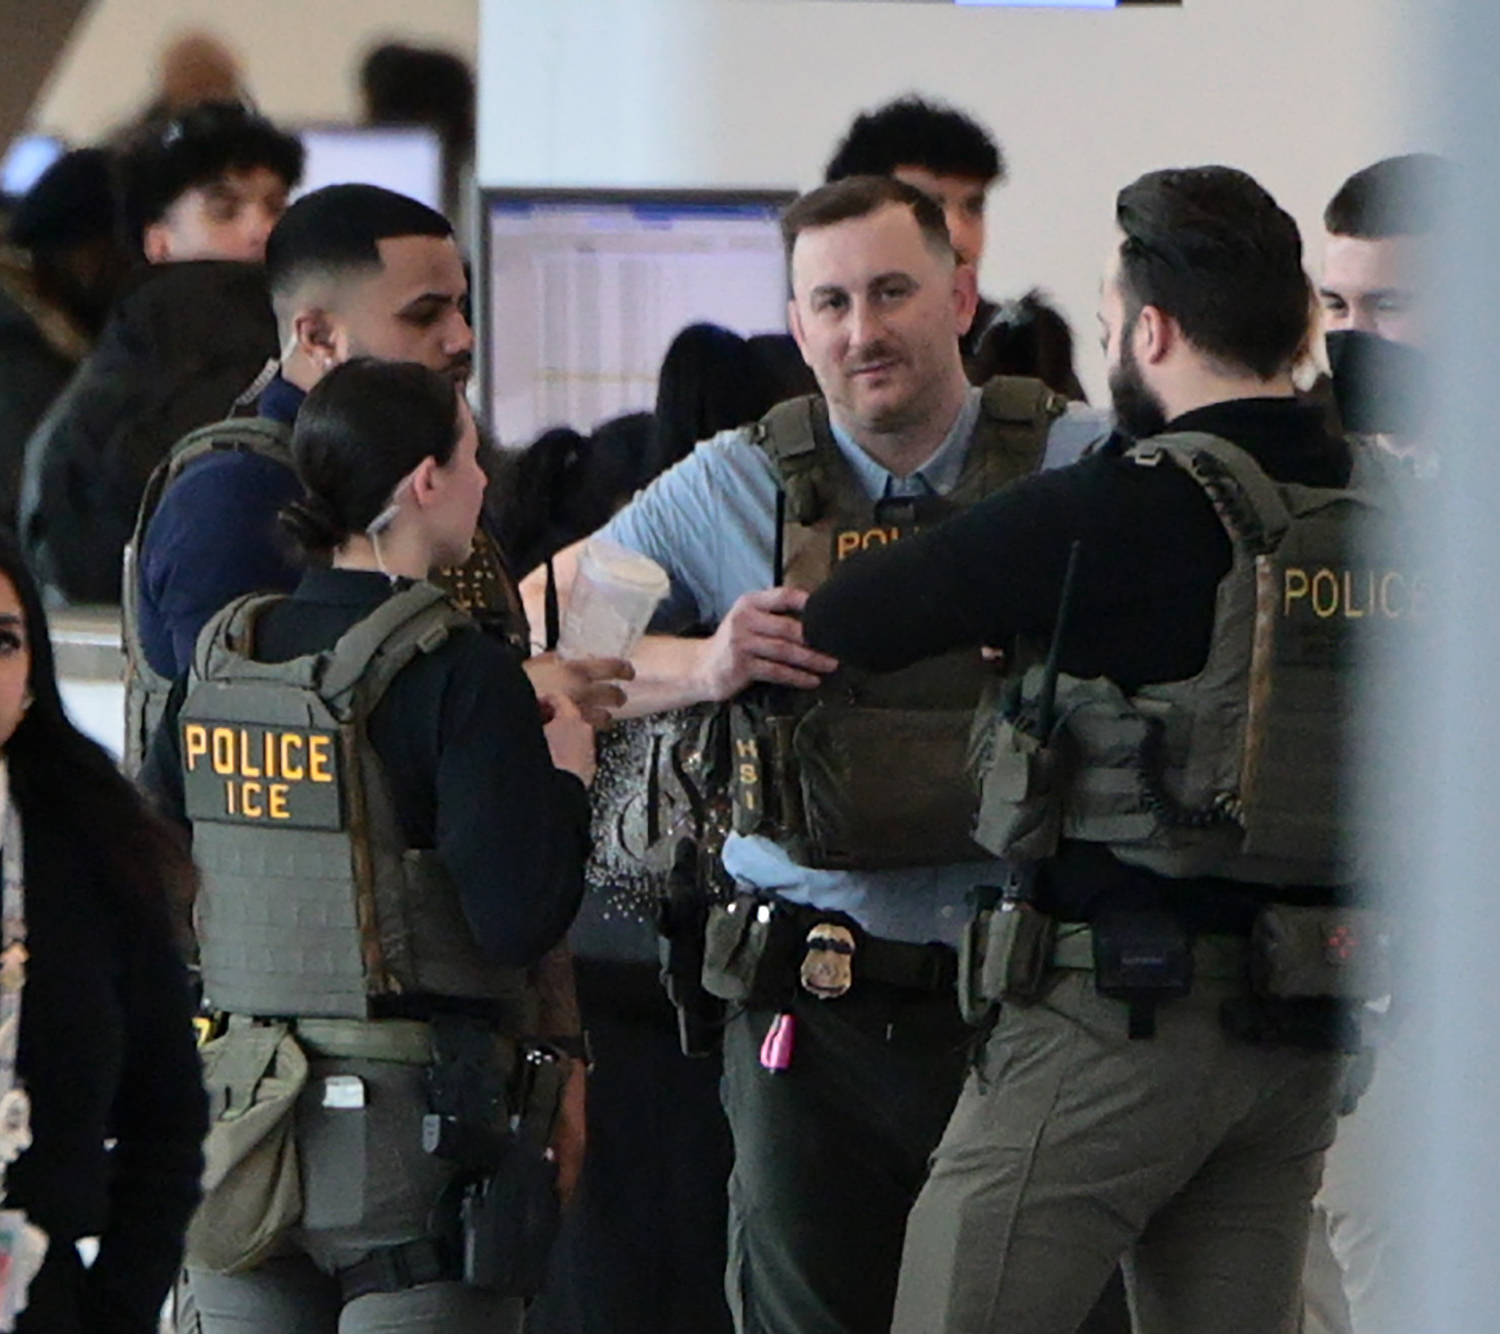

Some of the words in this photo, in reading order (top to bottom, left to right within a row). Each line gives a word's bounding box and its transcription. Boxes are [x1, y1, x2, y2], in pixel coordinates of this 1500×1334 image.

[1285, 567, 1426, 619] POLIC
[185, 724, 333, 782] POLICE
[736, 739, 758, 810] HSI
[227, 780, 291, 819] ICE
